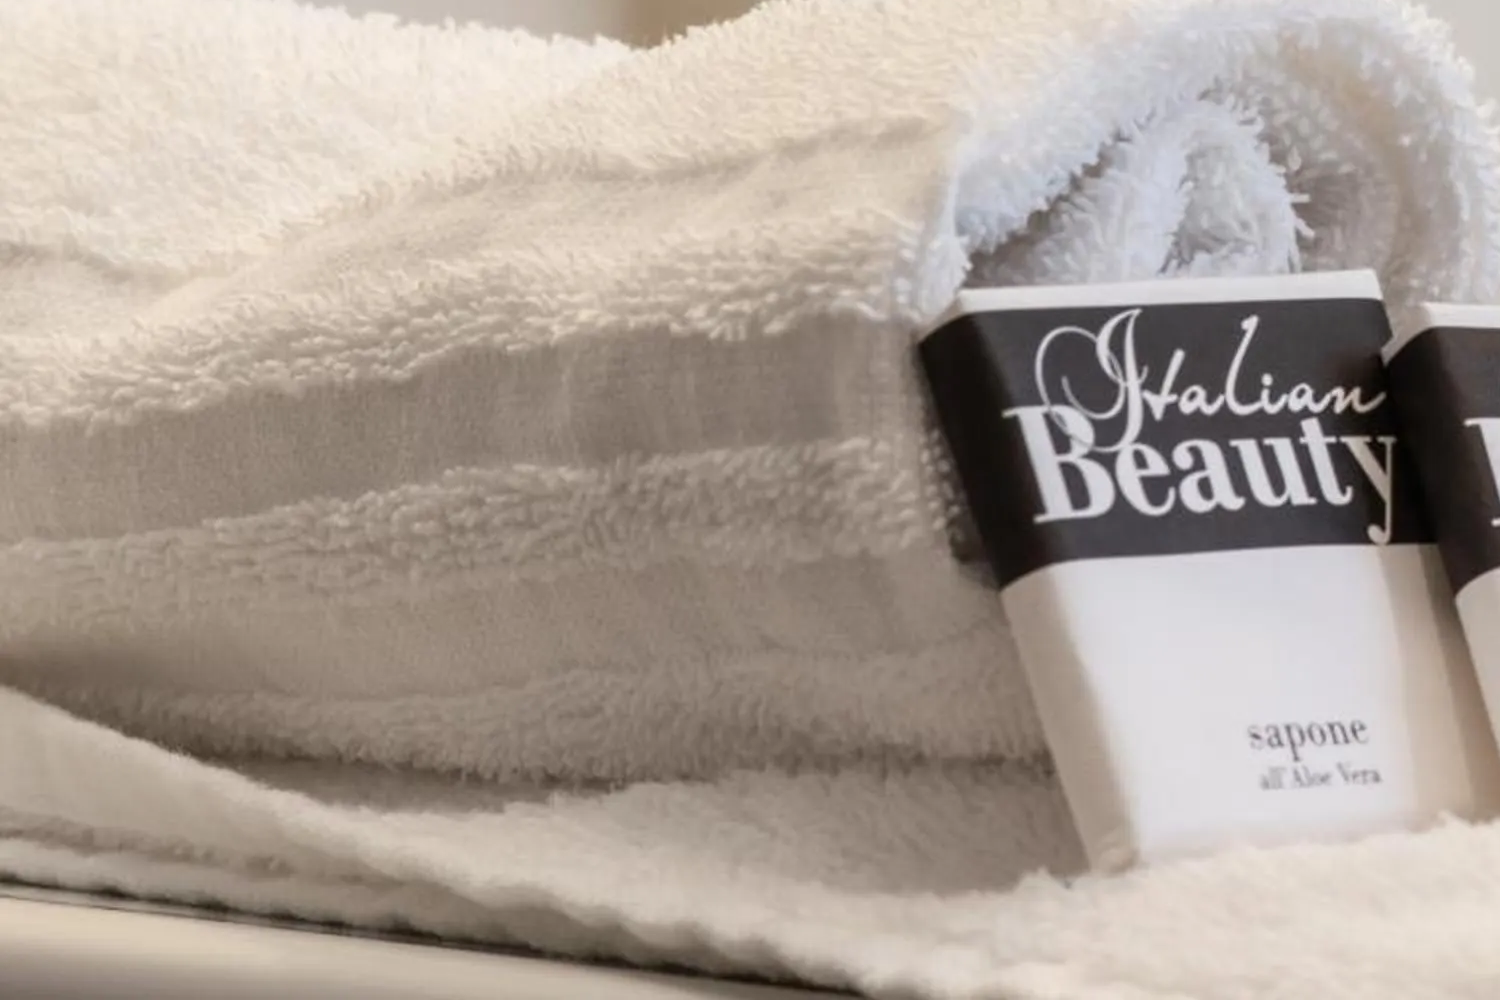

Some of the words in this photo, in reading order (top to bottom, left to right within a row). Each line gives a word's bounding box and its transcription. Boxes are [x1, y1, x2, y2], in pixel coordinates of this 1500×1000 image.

[1035, 308, 1387, 454] Italian
[1002, 403, 1397, 545] Beauty
[1247, 719, 1370, 762] sapone
